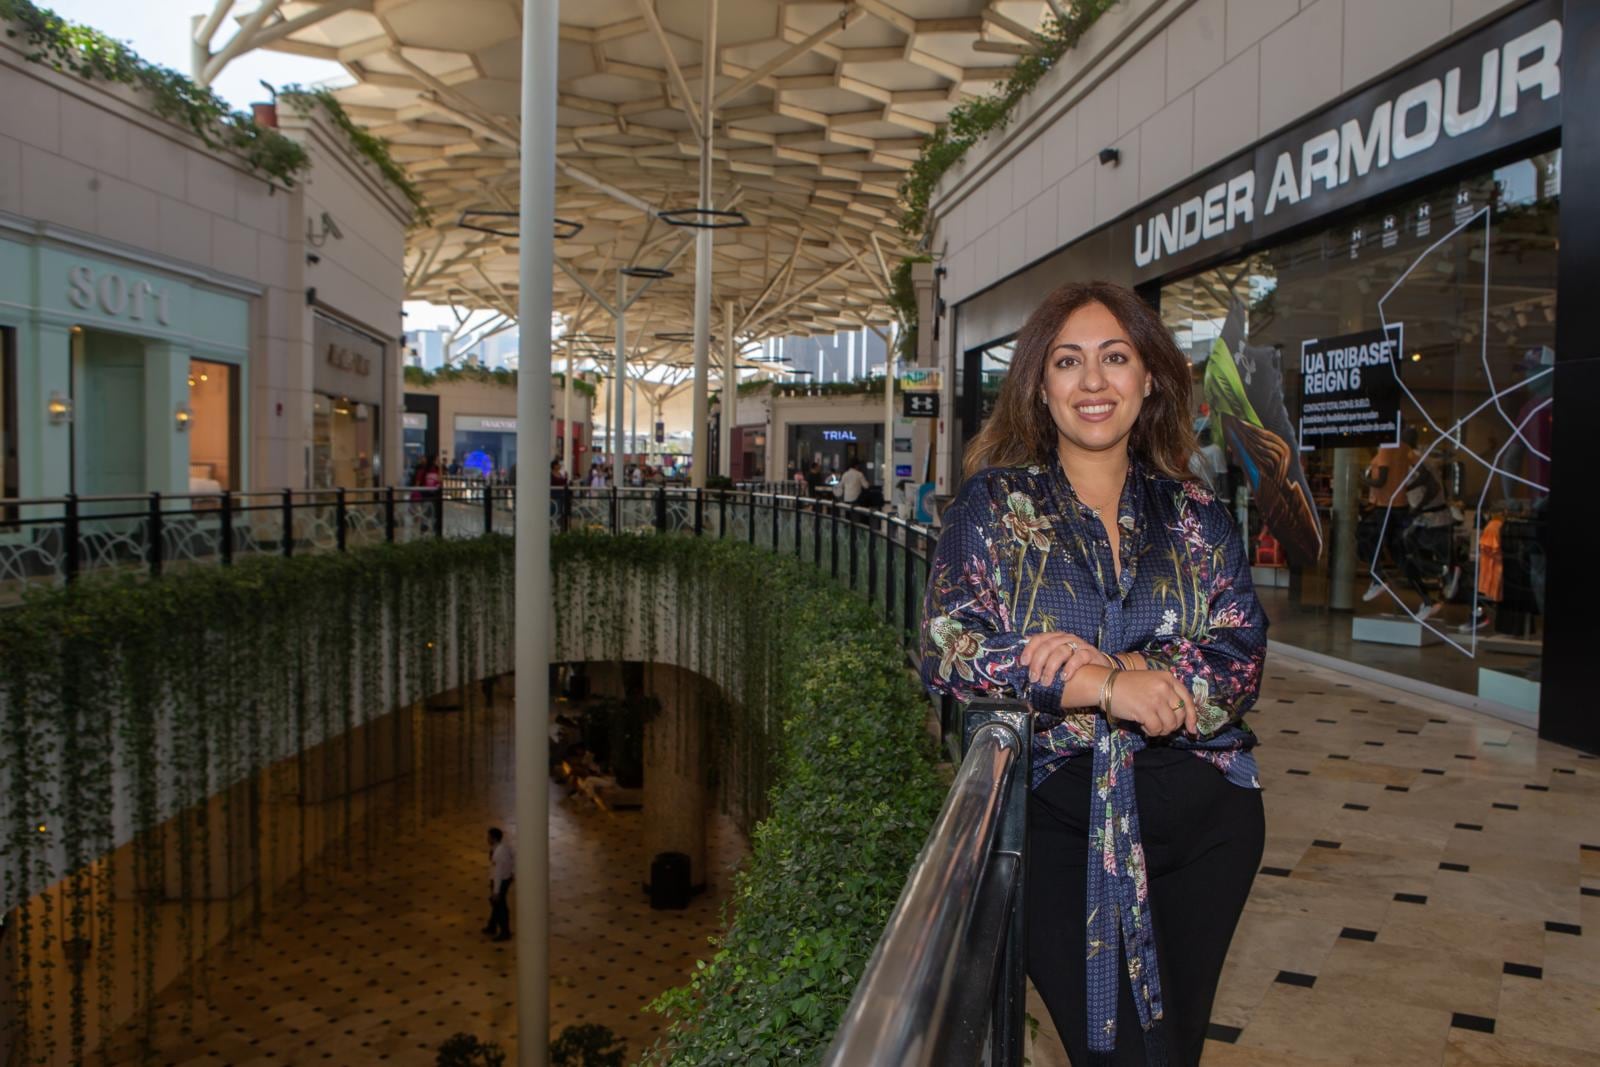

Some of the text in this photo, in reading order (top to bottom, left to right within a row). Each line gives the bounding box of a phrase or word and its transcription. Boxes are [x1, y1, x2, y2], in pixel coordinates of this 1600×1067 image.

[1134, 19, 1562, 267] UNDER ARMOUR
[1305, 352, 1325, 373] UA
[1305, 368, 1361, 394] REIGN 6
[823, 430, 857, 441] TRIAL
